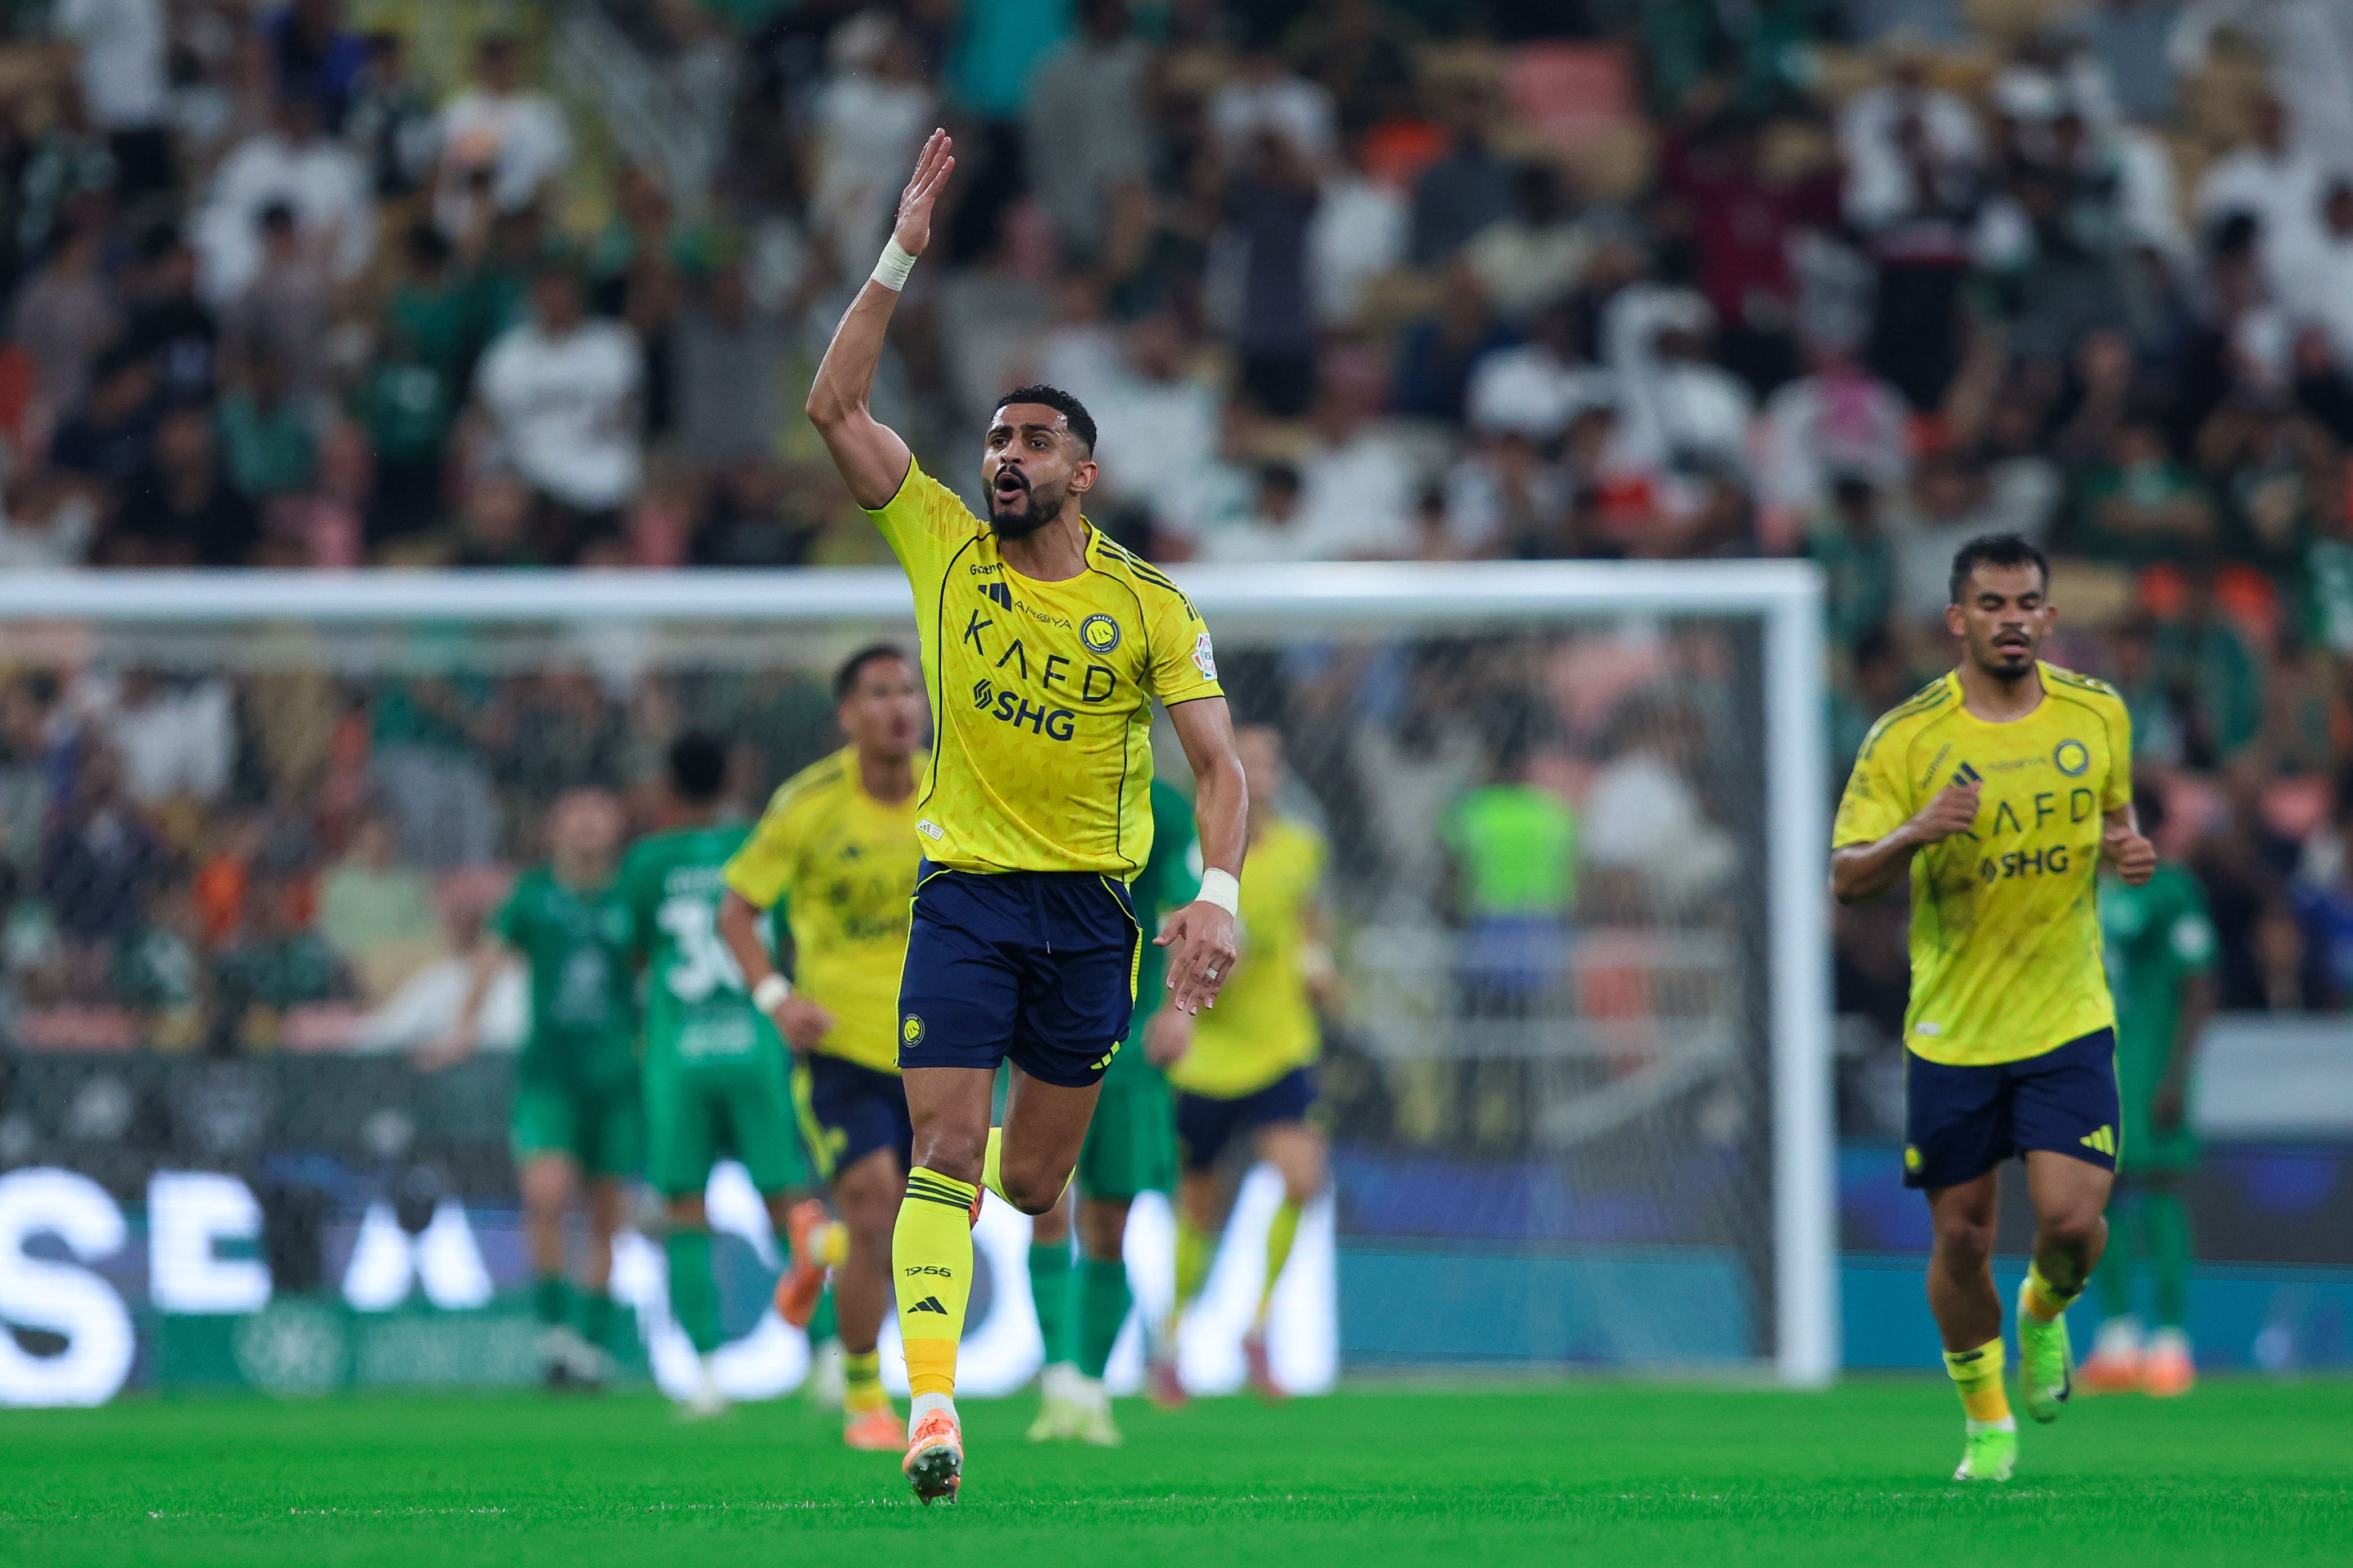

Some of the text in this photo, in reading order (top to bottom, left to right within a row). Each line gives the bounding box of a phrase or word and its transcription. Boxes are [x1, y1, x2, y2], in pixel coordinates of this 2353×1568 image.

[964, 608, 1117, 703] KAFD
[992, 691, 1076, 742] SHG
[1965, 788, 2096, 841] AFD
[2001, 845, 2069, 878] SHG
